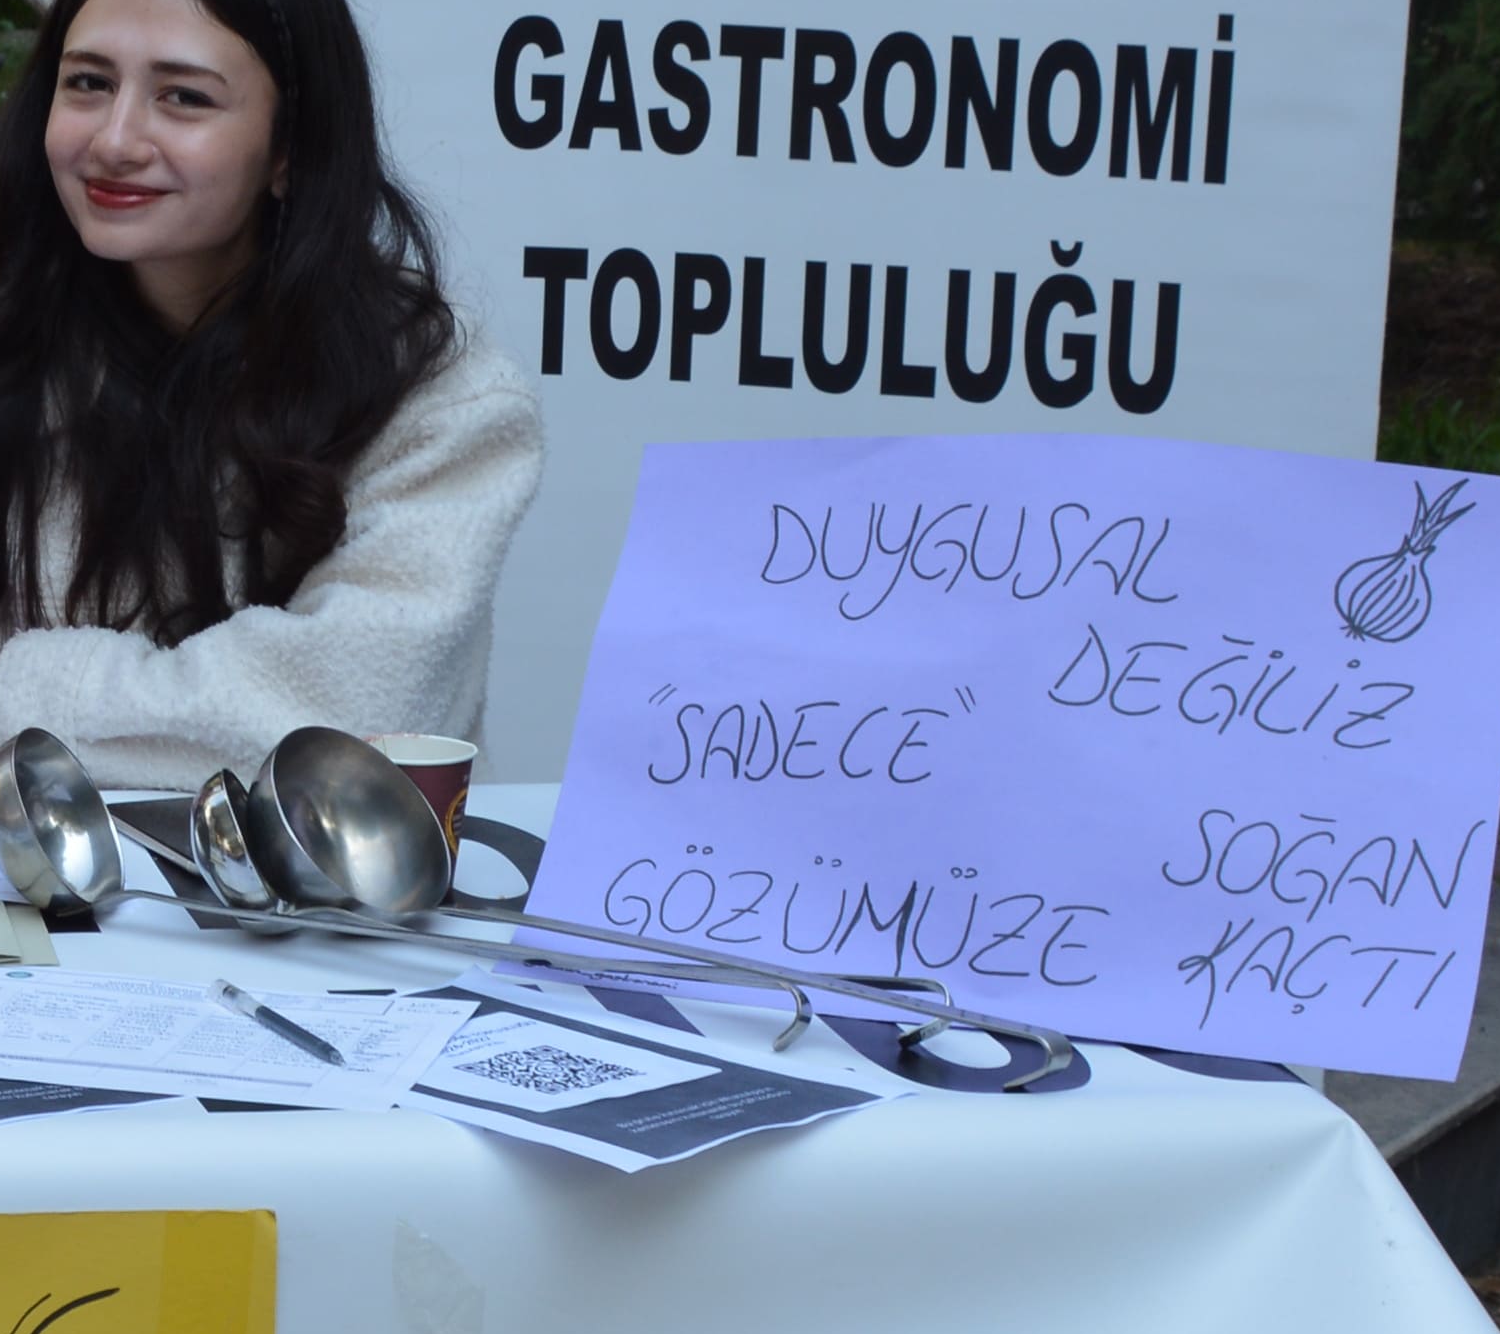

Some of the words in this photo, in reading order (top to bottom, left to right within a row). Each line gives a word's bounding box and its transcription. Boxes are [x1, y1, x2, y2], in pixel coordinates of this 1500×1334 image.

[492, 13, 1237, 186] GASTRONOMİ
[522, 240, 1182, 415] TOPLULUĞU
[760, 502, 1179, 621] DUYGUSAL
[1047, 622, 1415, 749] DEĞİLİZ
[604, 843, 1111, 986] GÖZÜMÜZE
[1161, 808, 1488, 923] SOĞAN
[1177, 918, 1457, 1031] KAÇTI
